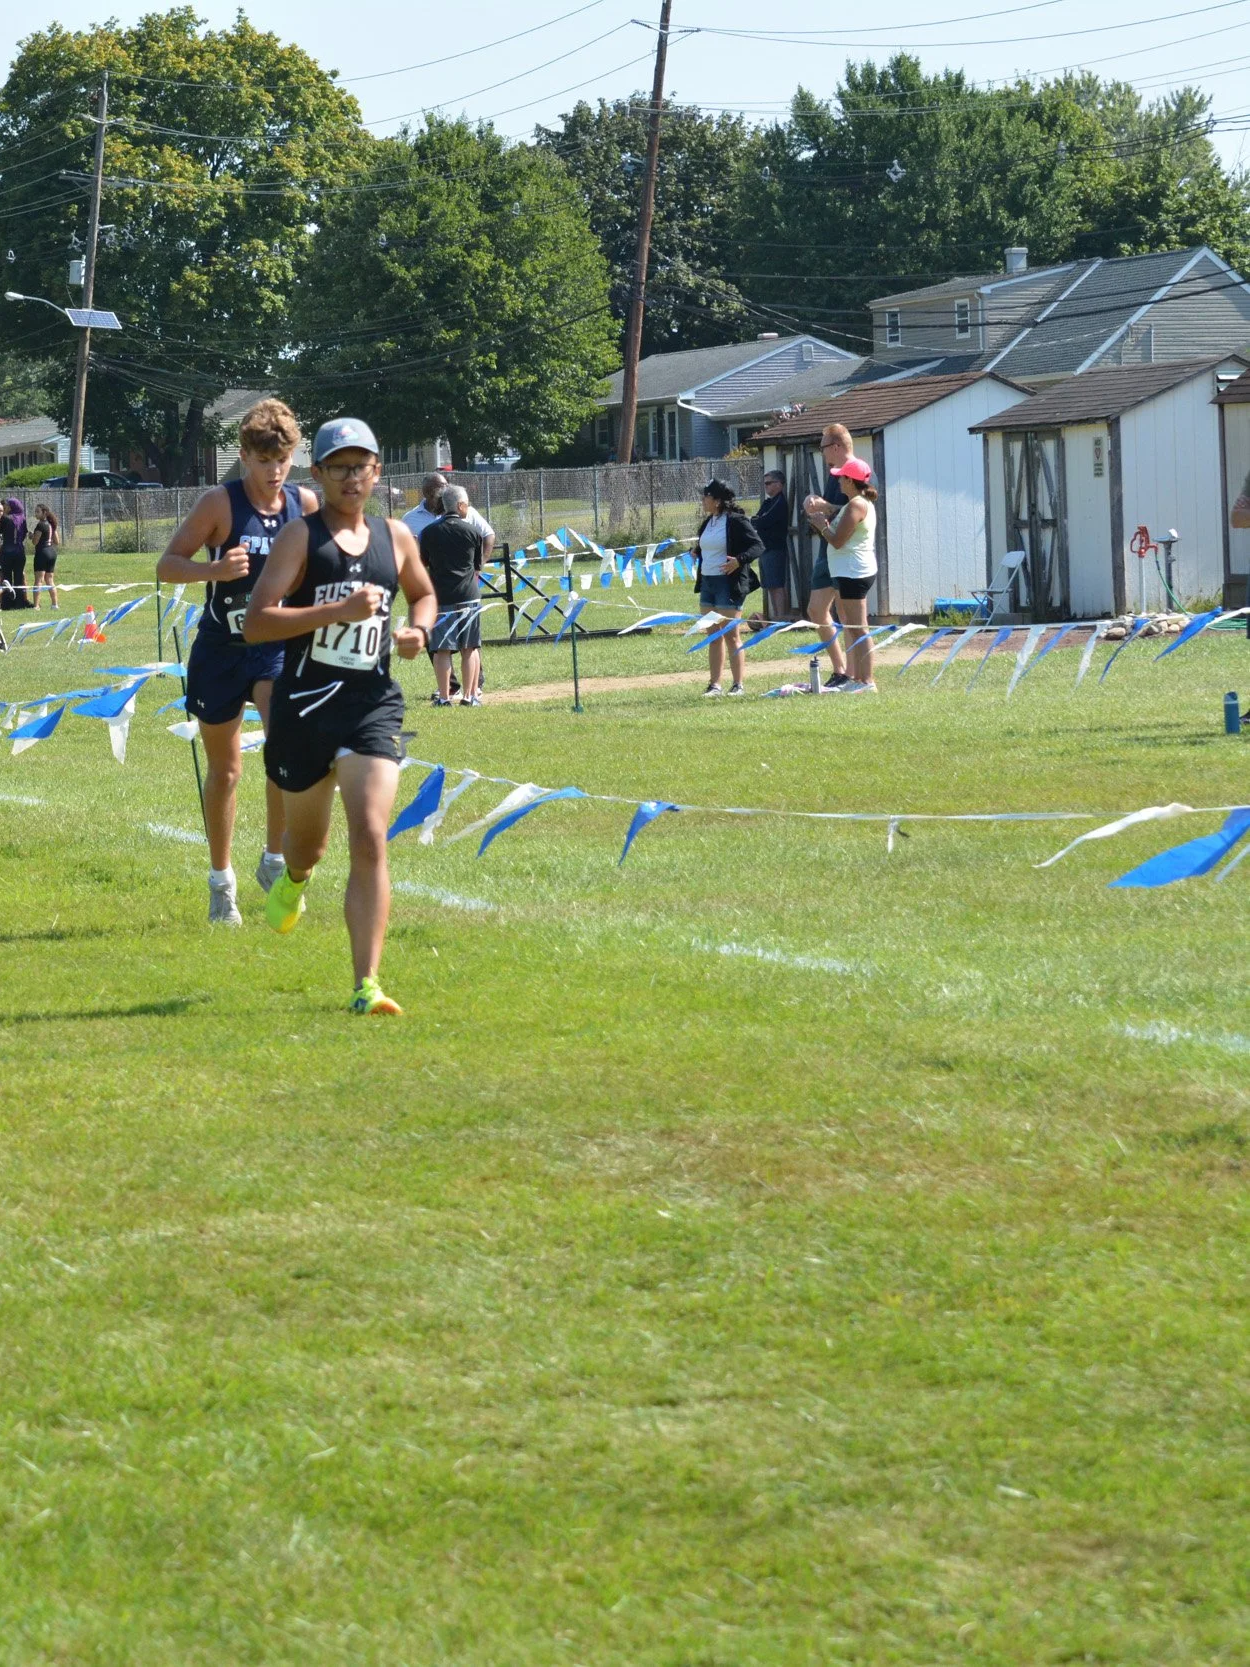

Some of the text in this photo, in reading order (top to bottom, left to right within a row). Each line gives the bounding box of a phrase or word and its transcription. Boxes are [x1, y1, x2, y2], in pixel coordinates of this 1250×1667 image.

[240, 535, 274, 555] SPA
[313, 581, 392, 612] EUSTE
[316, 622, 378, 656] 1710
